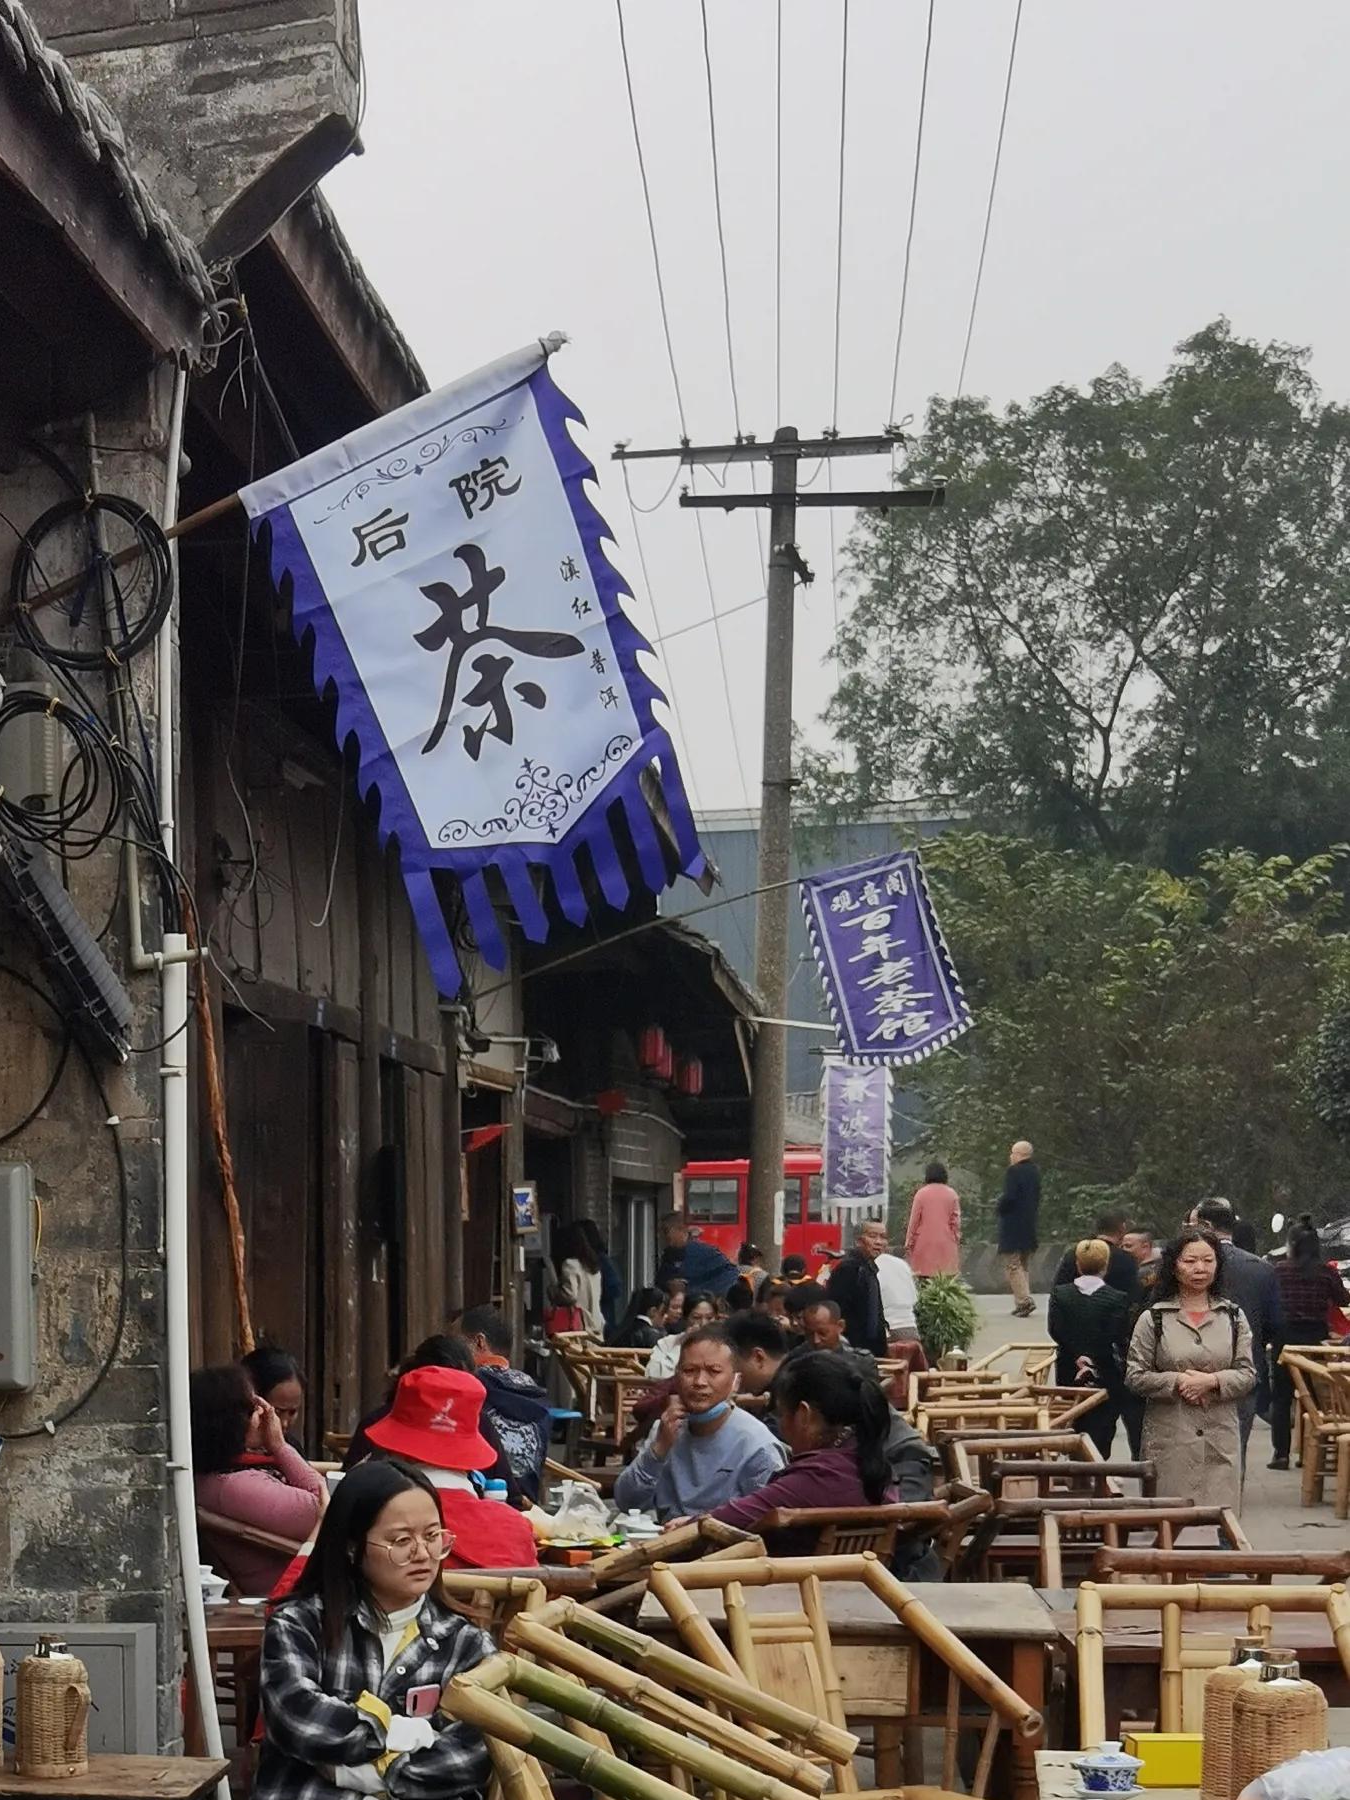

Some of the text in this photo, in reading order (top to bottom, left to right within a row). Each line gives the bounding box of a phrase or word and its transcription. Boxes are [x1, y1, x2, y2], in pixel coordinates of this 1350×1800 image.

[351, 456, 522, 567] 后院
[413, 544, 585, 761] 茶
[830, 869, 908, 913] 观音阁
[839, 903, 935, 1042] 百年老茶馆
